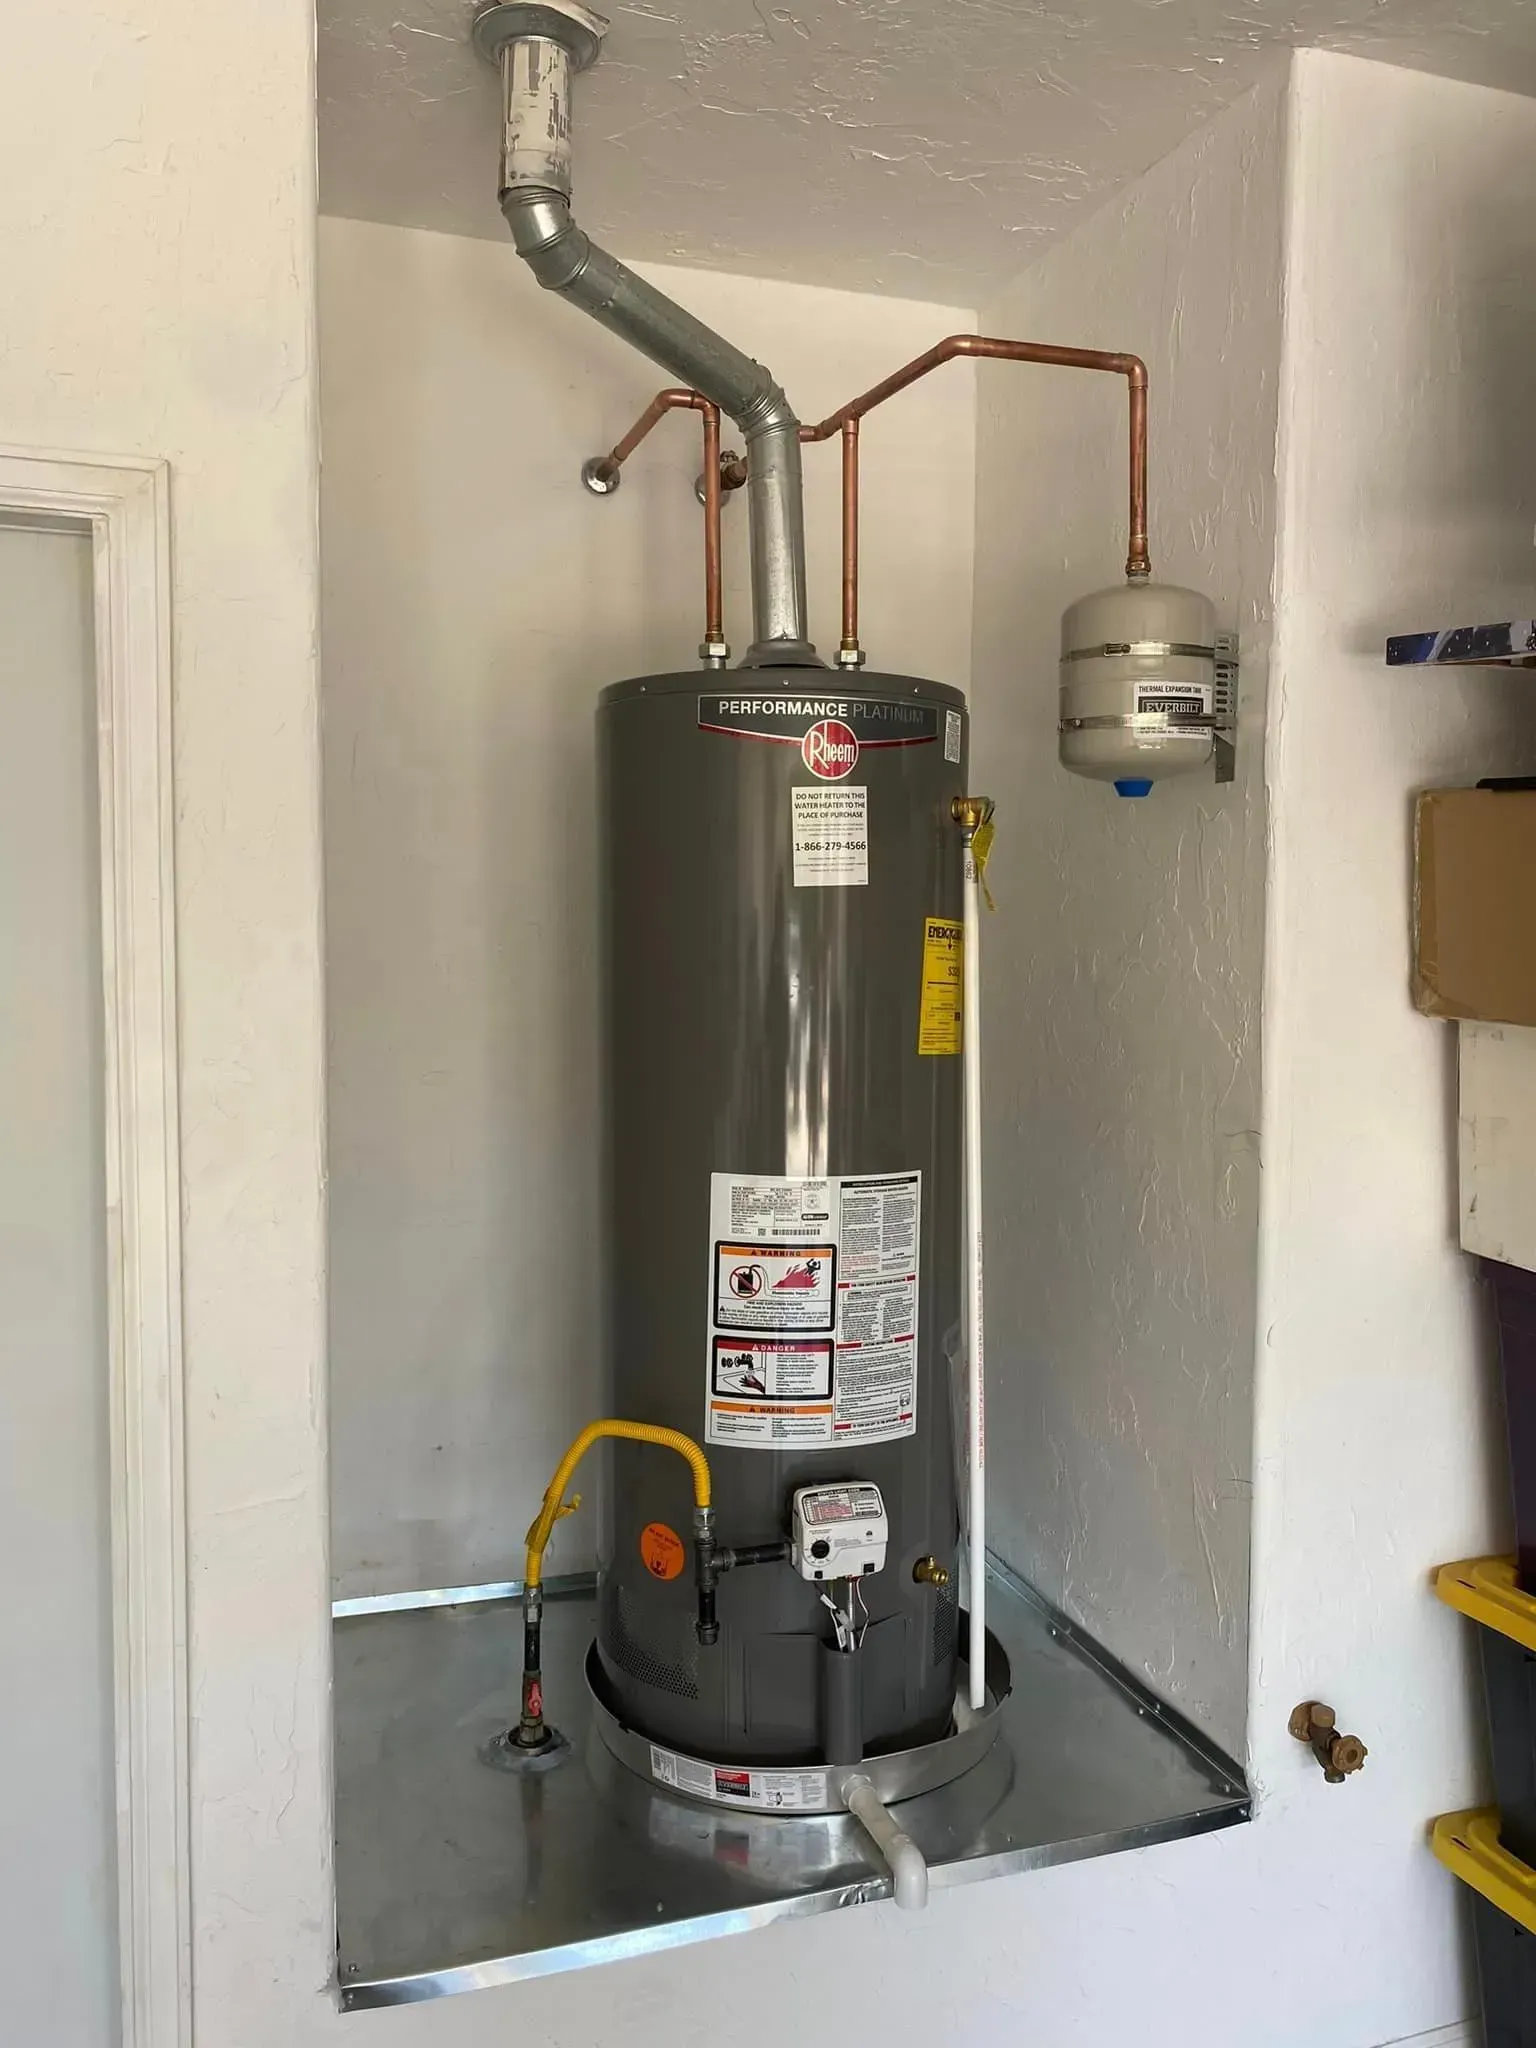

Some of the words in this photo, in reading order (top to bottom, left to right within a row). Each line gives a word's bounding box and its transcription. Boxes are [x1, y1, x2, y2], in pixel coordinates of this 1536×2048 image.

[1139, 685, 1164, 693] THERMAL
[1165, 685, 1192, 694] EXPANSION
[719, 701, 848, 717] PERFORMANCE
[853, 704, 924, 724] PLATINUM
[1145, 702, 1201, 713] EVERBILT
[810, 721, 855, 769] Rheem
[824, 792, 850, 800] RETURN
[795, 841, 867, 852] 1-866-279-4566
[760, 1249, 802, 1257] WARNING
[760, 1406, 796, 1414] WARNING
